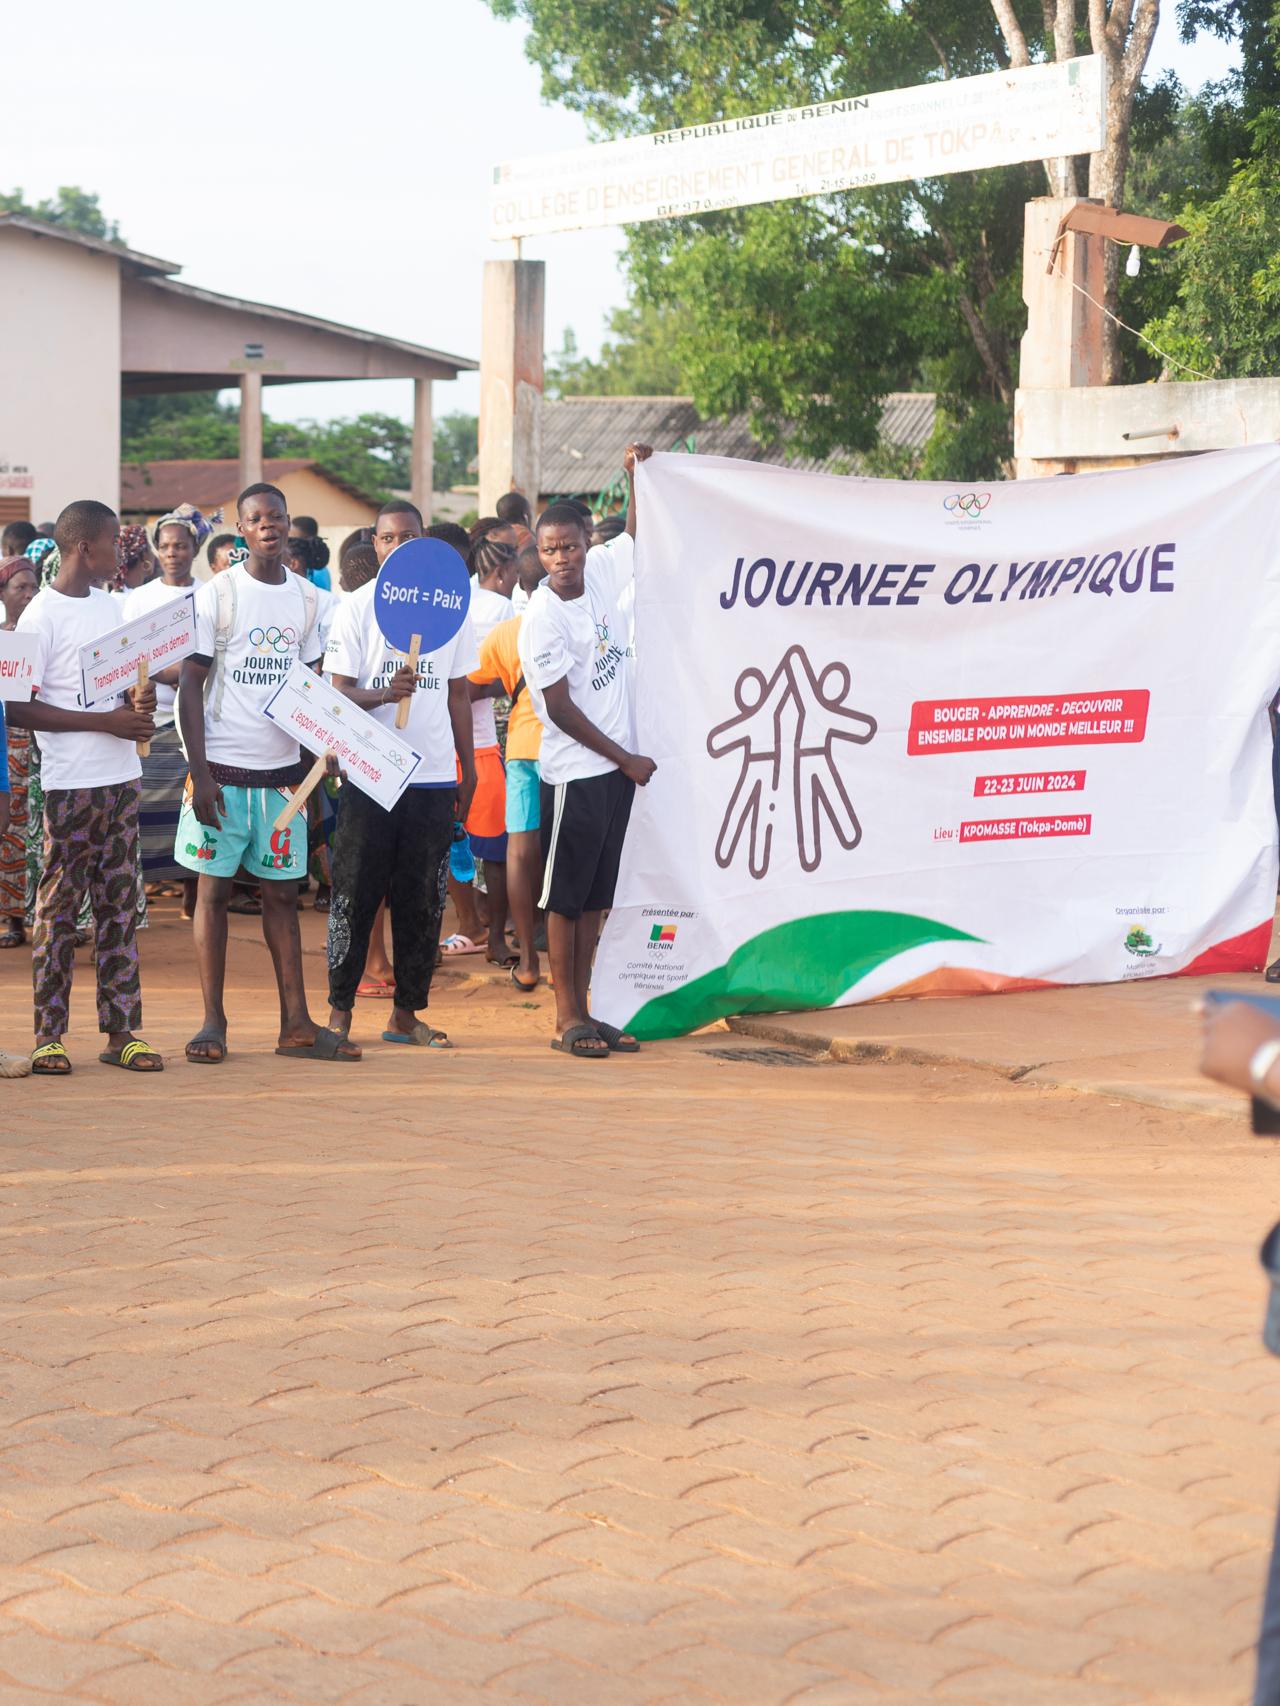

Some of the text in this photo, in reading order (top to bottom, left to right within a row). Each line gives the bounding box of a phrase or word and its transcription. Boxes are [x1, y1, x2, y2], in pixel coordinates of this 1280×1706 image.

[654, 112, 783, 146] REPUBLIQUE
[801, 97, 870, 121] BENIN
[492, 190, 579, 227] COLLEGE
[771, 148, 877, 183] GENERAL
[885, 135, 914, 165] DE
[719, 542, 1177, 610] JOURNEE OLYMPIQUE
[380, 581, 420, 606] Sport
[432, 588, 464, 611] Paix
[93, 663, 122, 690] Transpire
[152, 640, 170, 660] souris
[169, 631, 190, 651] demain
[933, 706, 979, 723] BOUGER
[987, 703, 1054, 720] APPRENDRE
[1061, 698, 1123, 716] DECOUVRIR
[289, 706, 318, 732] L'espoir
[314, 727, 329, 742] est
[325, 733, 334, 747] le
[348, 752, 359, 767] du
[356, 758, 383, 784] monde
[917, 719, 1135, 746] ENSEMBLE POUR UN MONDE MEILLEUR !!!
[983, 774, 1077, 794] 22-23 JUIN 2024
[933, 826, 954, 840] Lieu
[963, 821, 1017, 838] KPOMASSE
[1018, 819, 1087, 836] (Tokpa-Domè)
[646, 942, 674, 950] BENIN
[618, 972, 689, 983] Olympique et Sportif
[626, 962, 685, 971] Comité National
